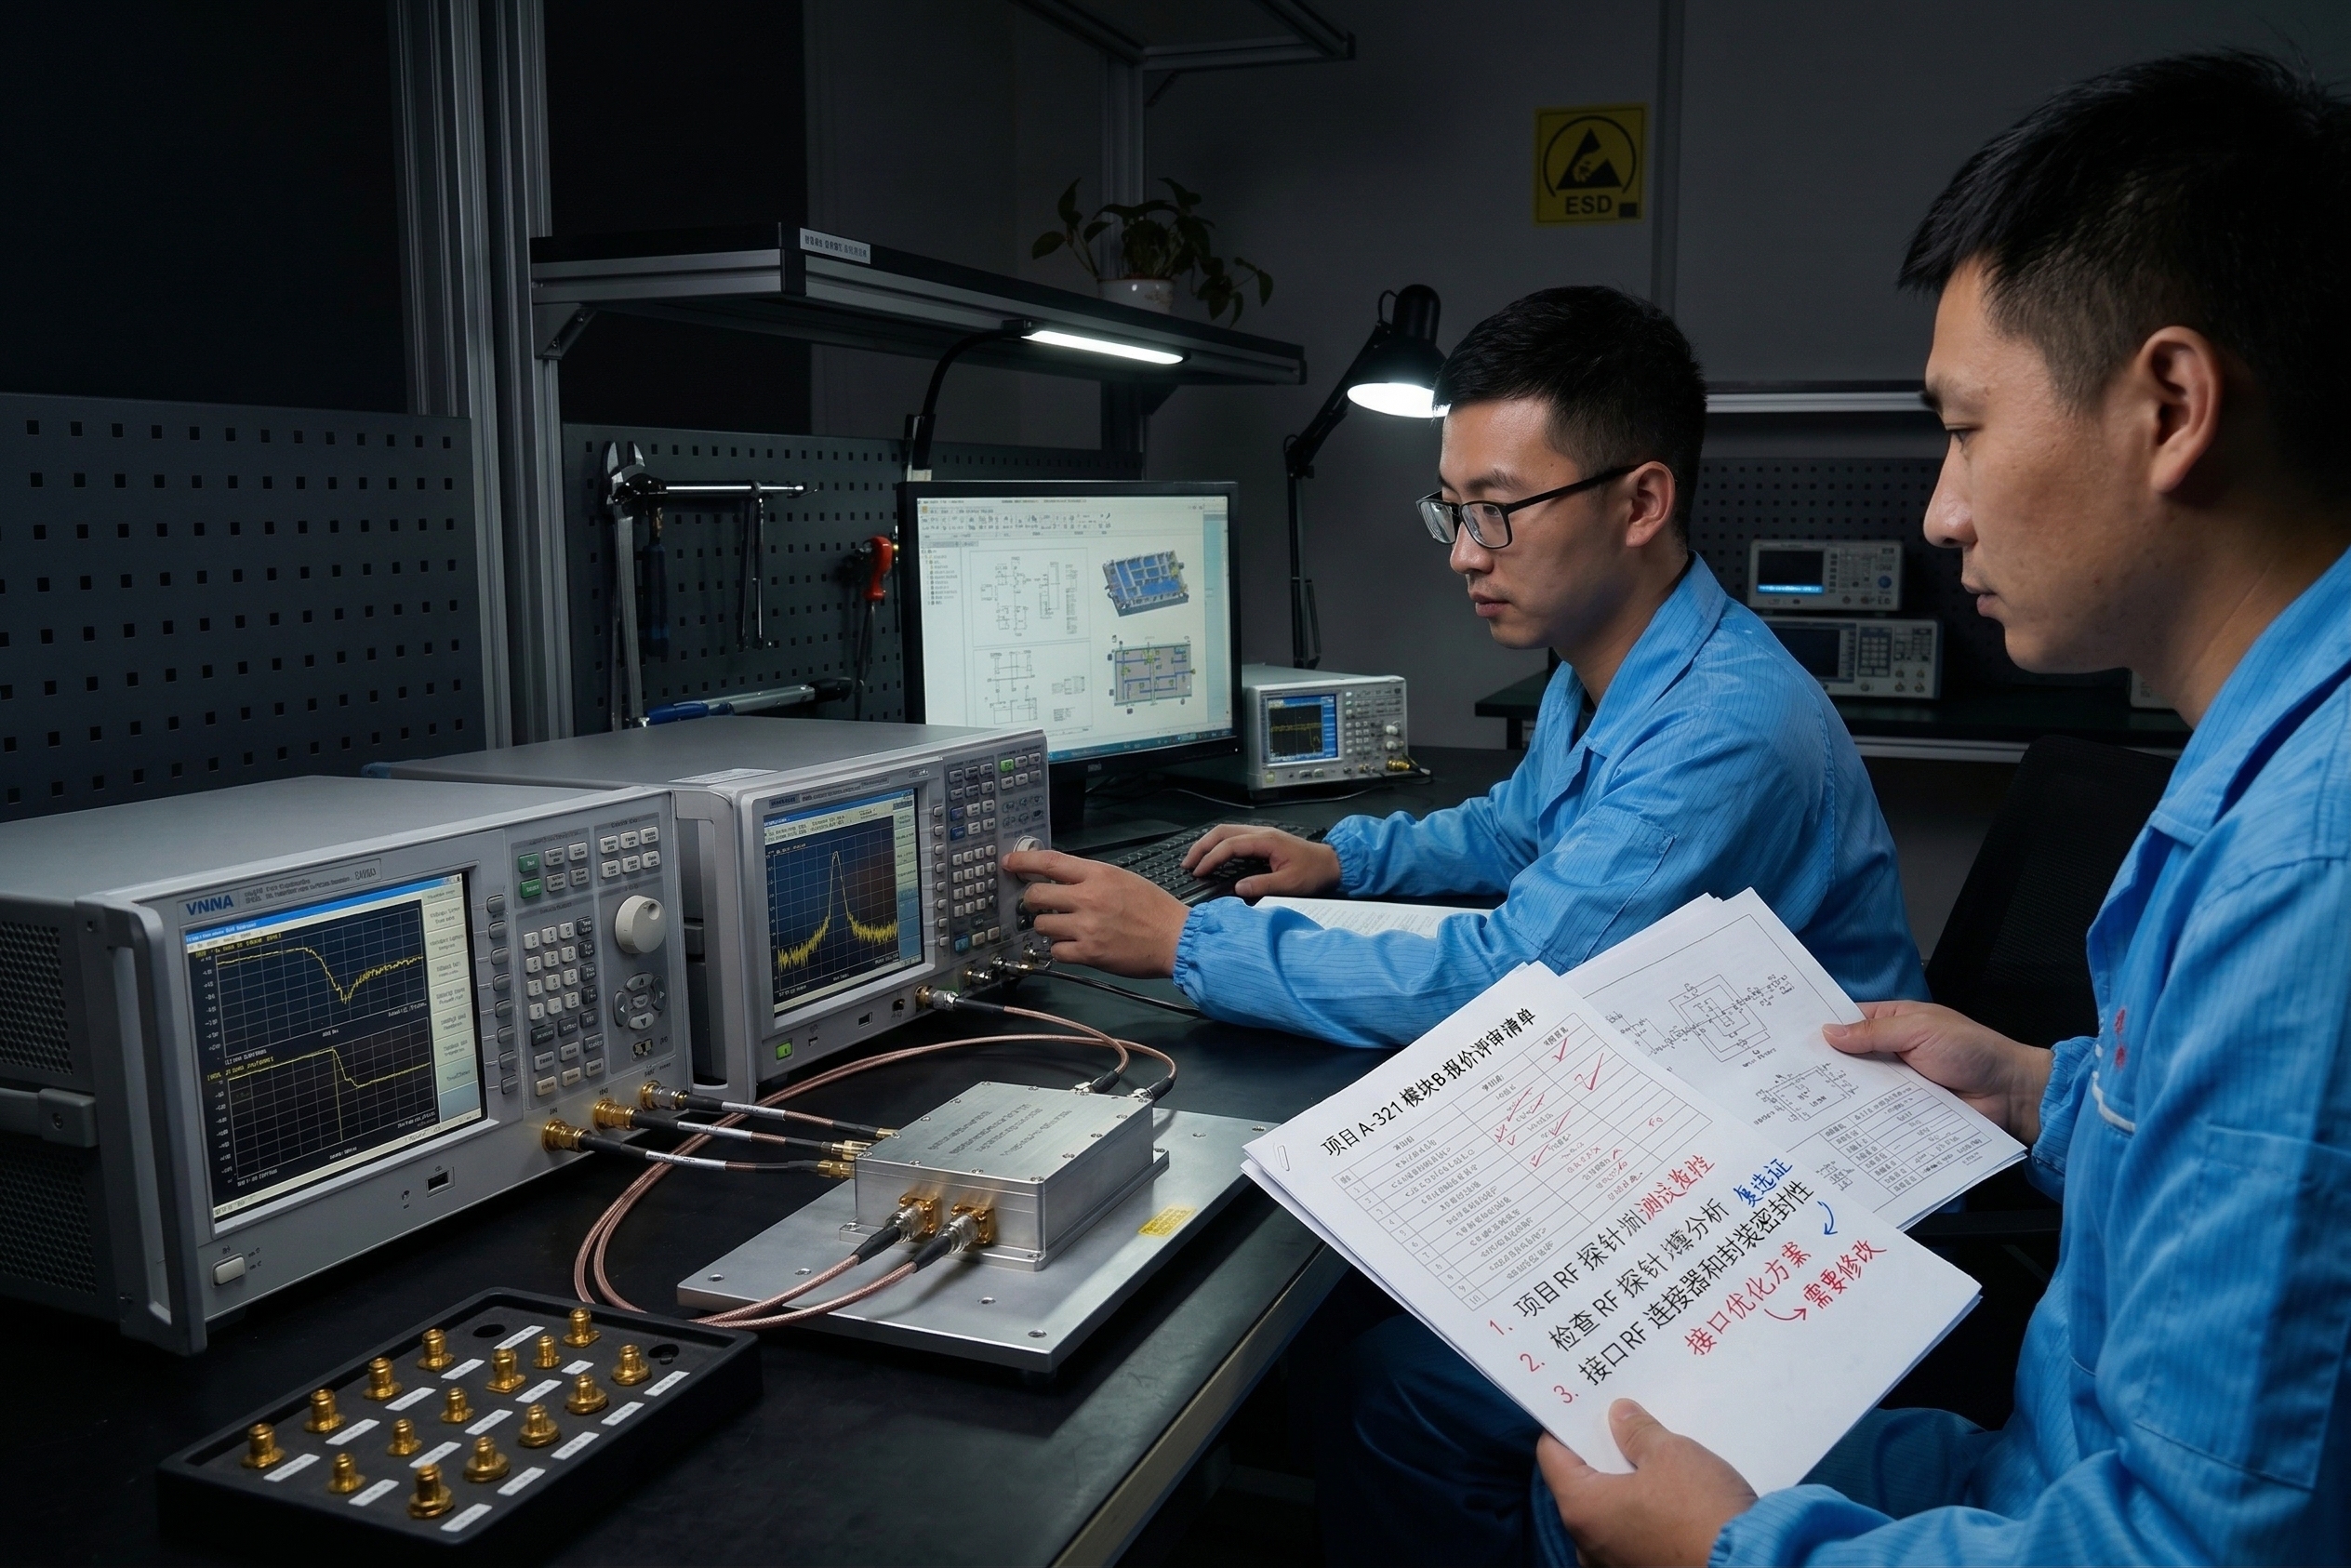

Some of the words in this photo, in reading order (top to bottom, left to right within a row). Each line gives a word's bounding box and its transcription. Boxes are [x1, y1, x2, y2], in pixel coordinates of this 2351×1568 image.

[1565, 194, 1613, 215] ESD
[1320, 1127, 1361, 1158] 项目
[1358, 1102, 1405, 1137] A-321
[1513, 1280, 1561, 1319] 项目
[1553, 1261, 1583, 1290] RF
[1802, 1239, 1889, 1310] 需要修改
[1519, 1352, 1547, 1374] 2.
[1547, 1309, 1601, 1353] 检查
[1592, 1289, 1621, 1318] RF
[1553, 1384, 1580, 1405] 3.
